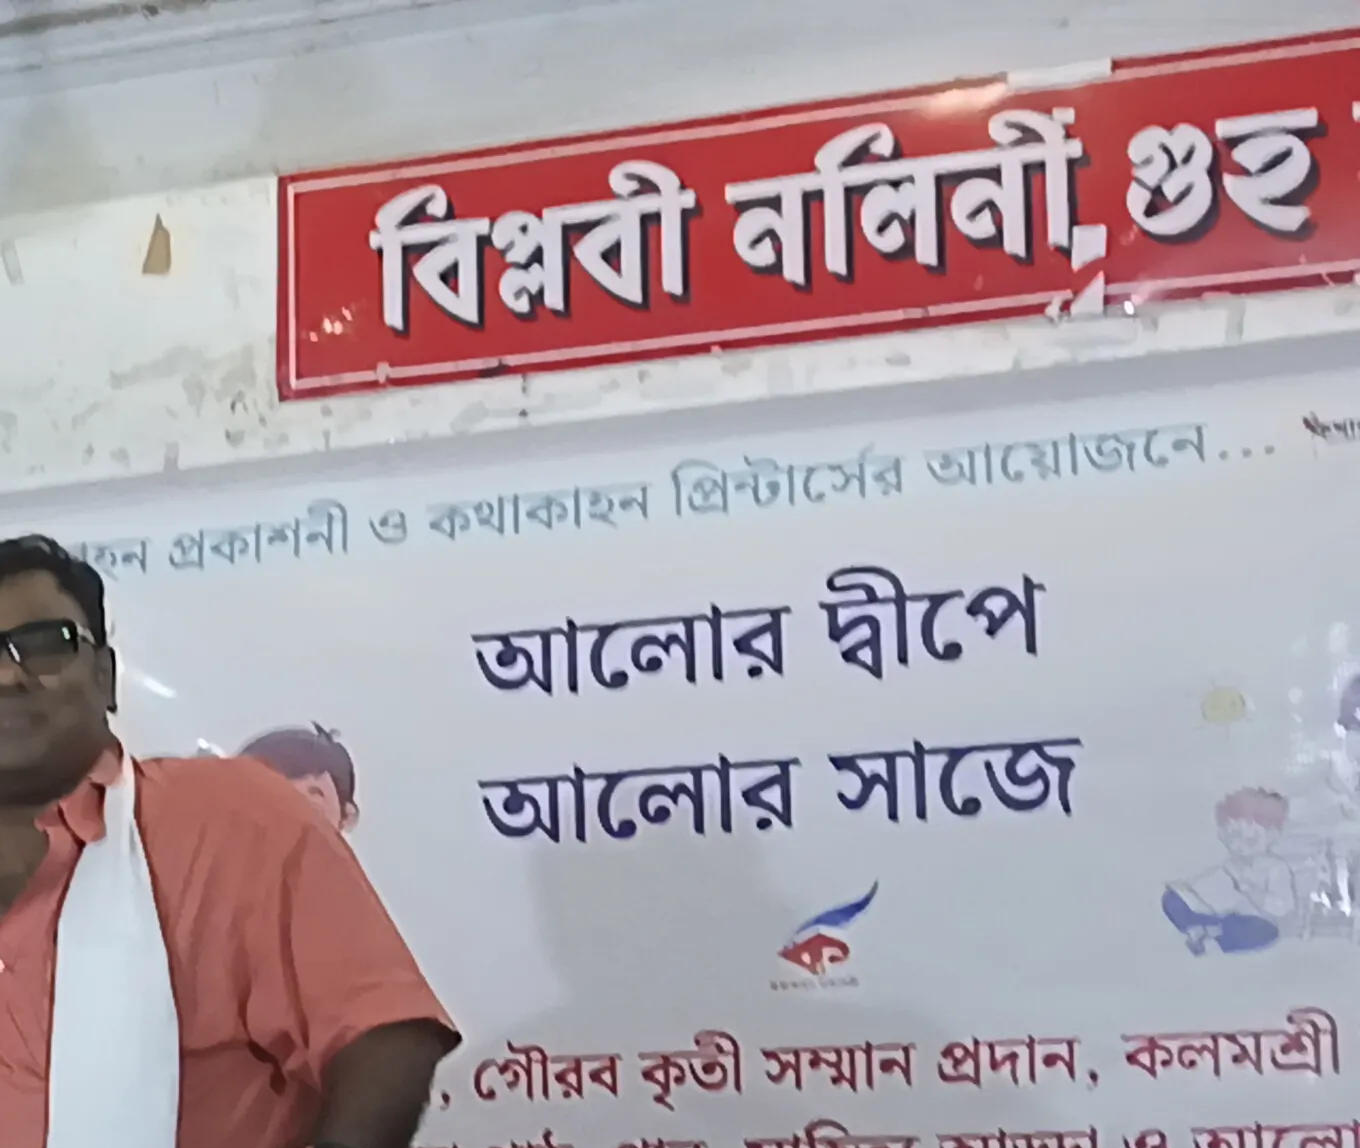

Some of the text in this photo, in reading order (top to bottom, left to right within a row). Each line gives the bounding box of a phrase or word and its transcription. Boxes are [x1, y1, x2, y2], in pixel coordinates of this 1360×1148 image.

[370, 107, 1320, 333] বিপ্লবী নলিনী গুহ
[169, 498, 348, 571] প্রকাশনী
[370, 508, 408, 544] ও
[430, 482, 650, 541] কথাকাহন
[671, 442, 905, 516] প্রিন্টার্সের
[472, 565, 1046, 698] আলোর দ্বীপে
[480, 737, 1081, 844] আলোর সাজে
[474, 1006, 1340, 1112] গৌরব কৃতী সম্মান প্রদান, কলমশ্রী
